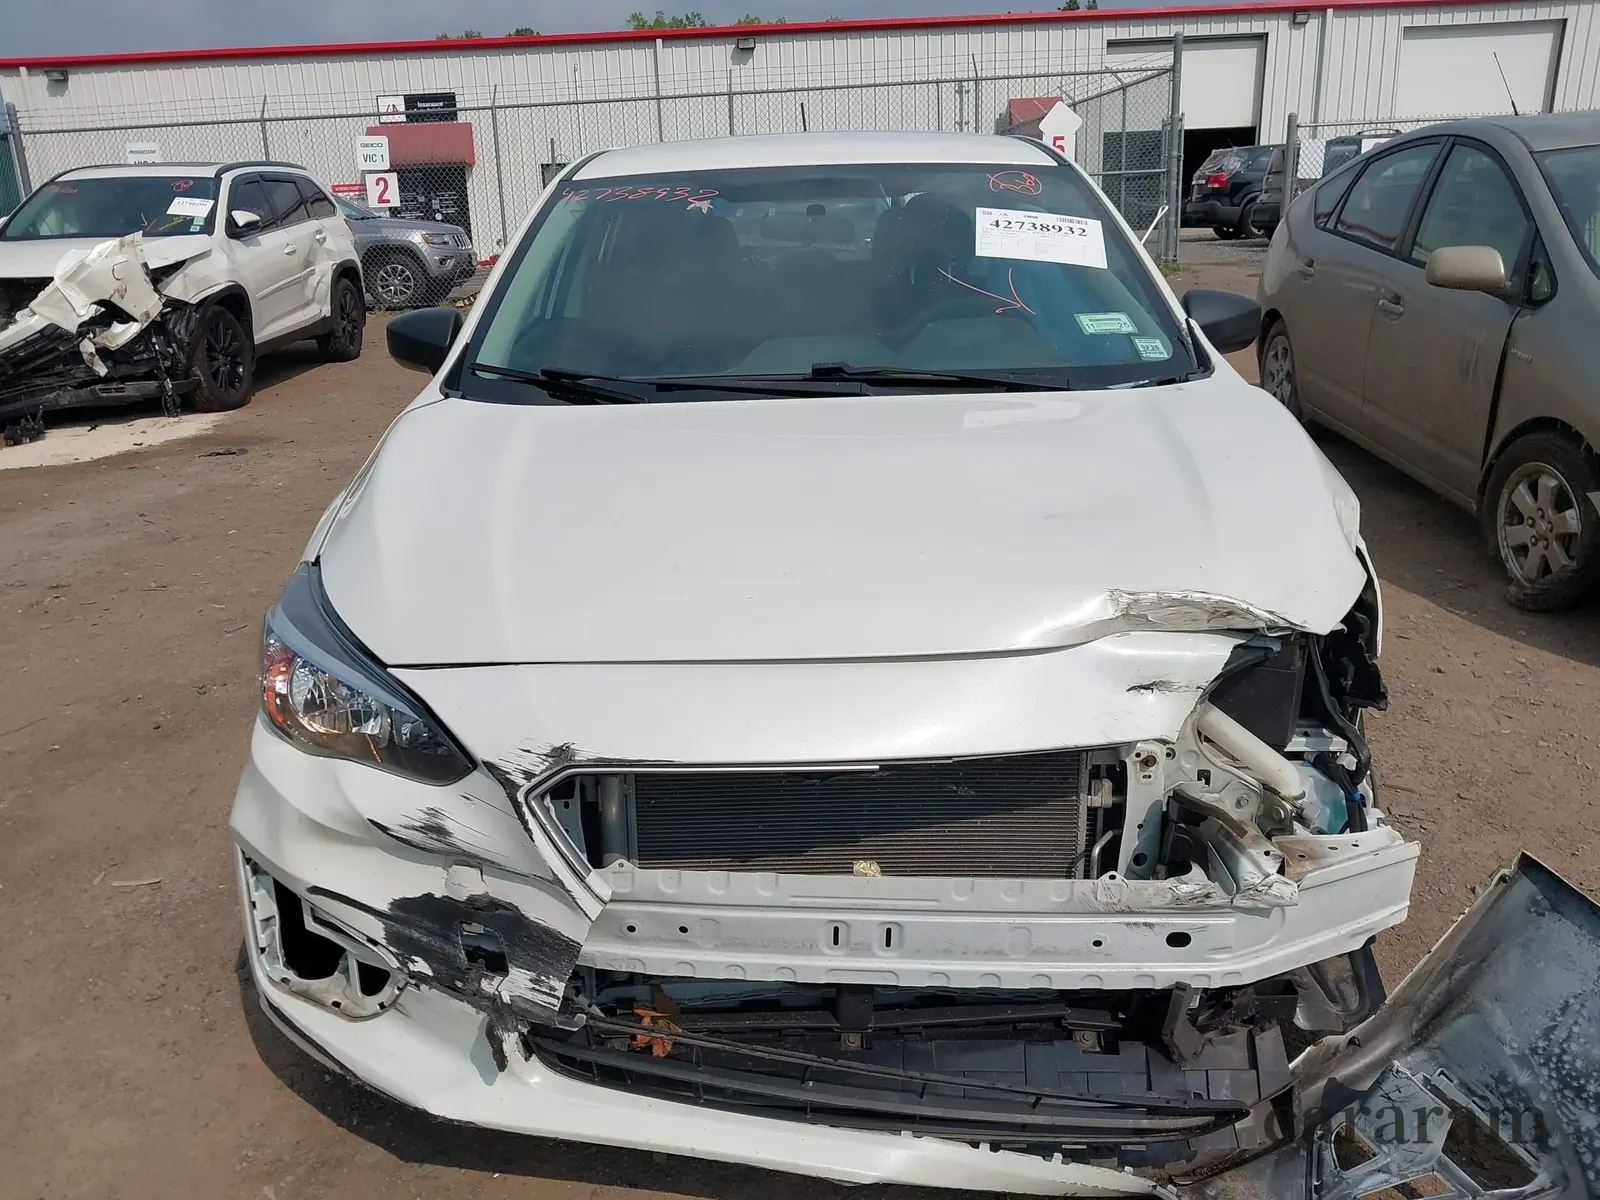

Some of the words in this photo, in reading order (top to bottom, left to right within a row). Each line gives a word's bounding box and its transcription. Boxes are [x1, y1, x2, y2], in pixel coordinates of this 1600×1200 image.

[362, 154, 377, 163] VIC
[380, 153, 385, 163] 1
[375, 177, 391, 204] 2
[989, 219, 1088, 237] 42738932
